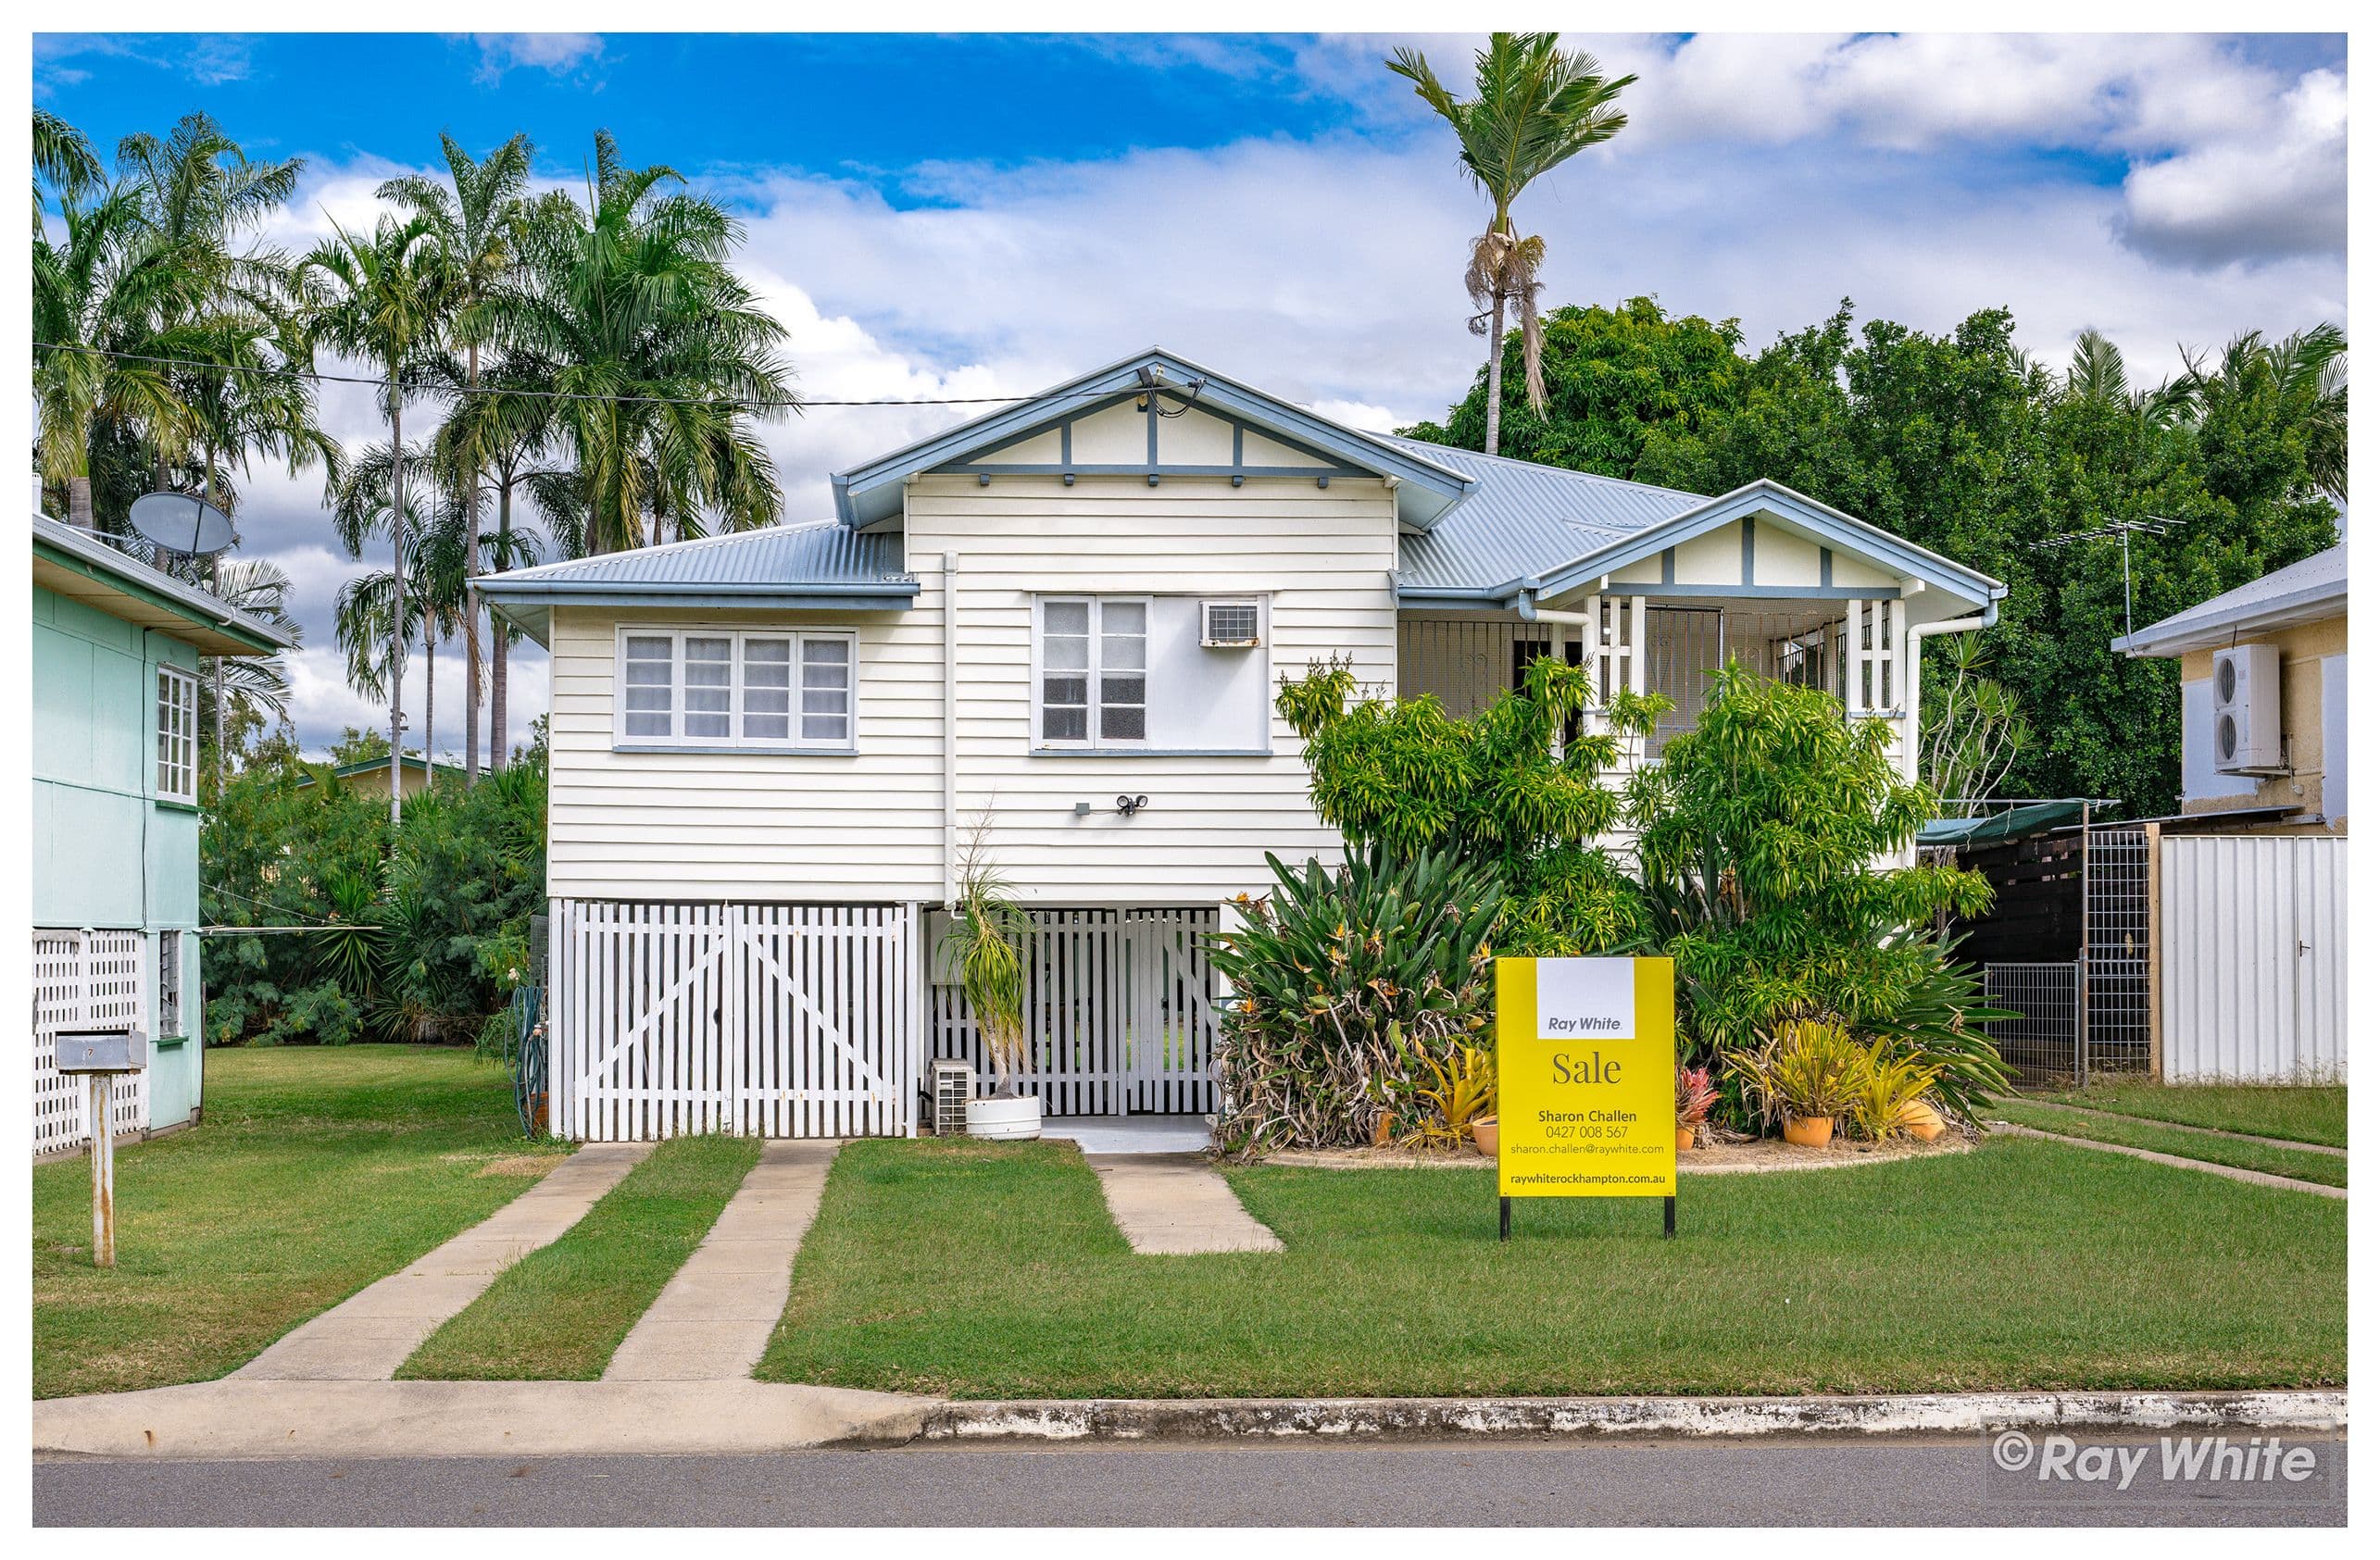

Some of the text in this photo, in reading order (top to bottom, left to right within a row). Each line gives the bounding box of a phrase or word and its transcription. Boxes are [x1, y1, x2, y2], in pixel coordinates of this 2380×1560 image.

[1548, 1017, 1621, 1032] Ray White
[1552, 1052, 1622, 1084] Sale
[1538, 1110, 1637, 1122] Sharon Challen
[1546, 1126, 1628, 1138] 0427 008 567
[1510, 1143, 1664, 1155] sharon.challen@raywhite.com
[1510, 1173, 1666, 1184] raywhiterockhampton.com.au
